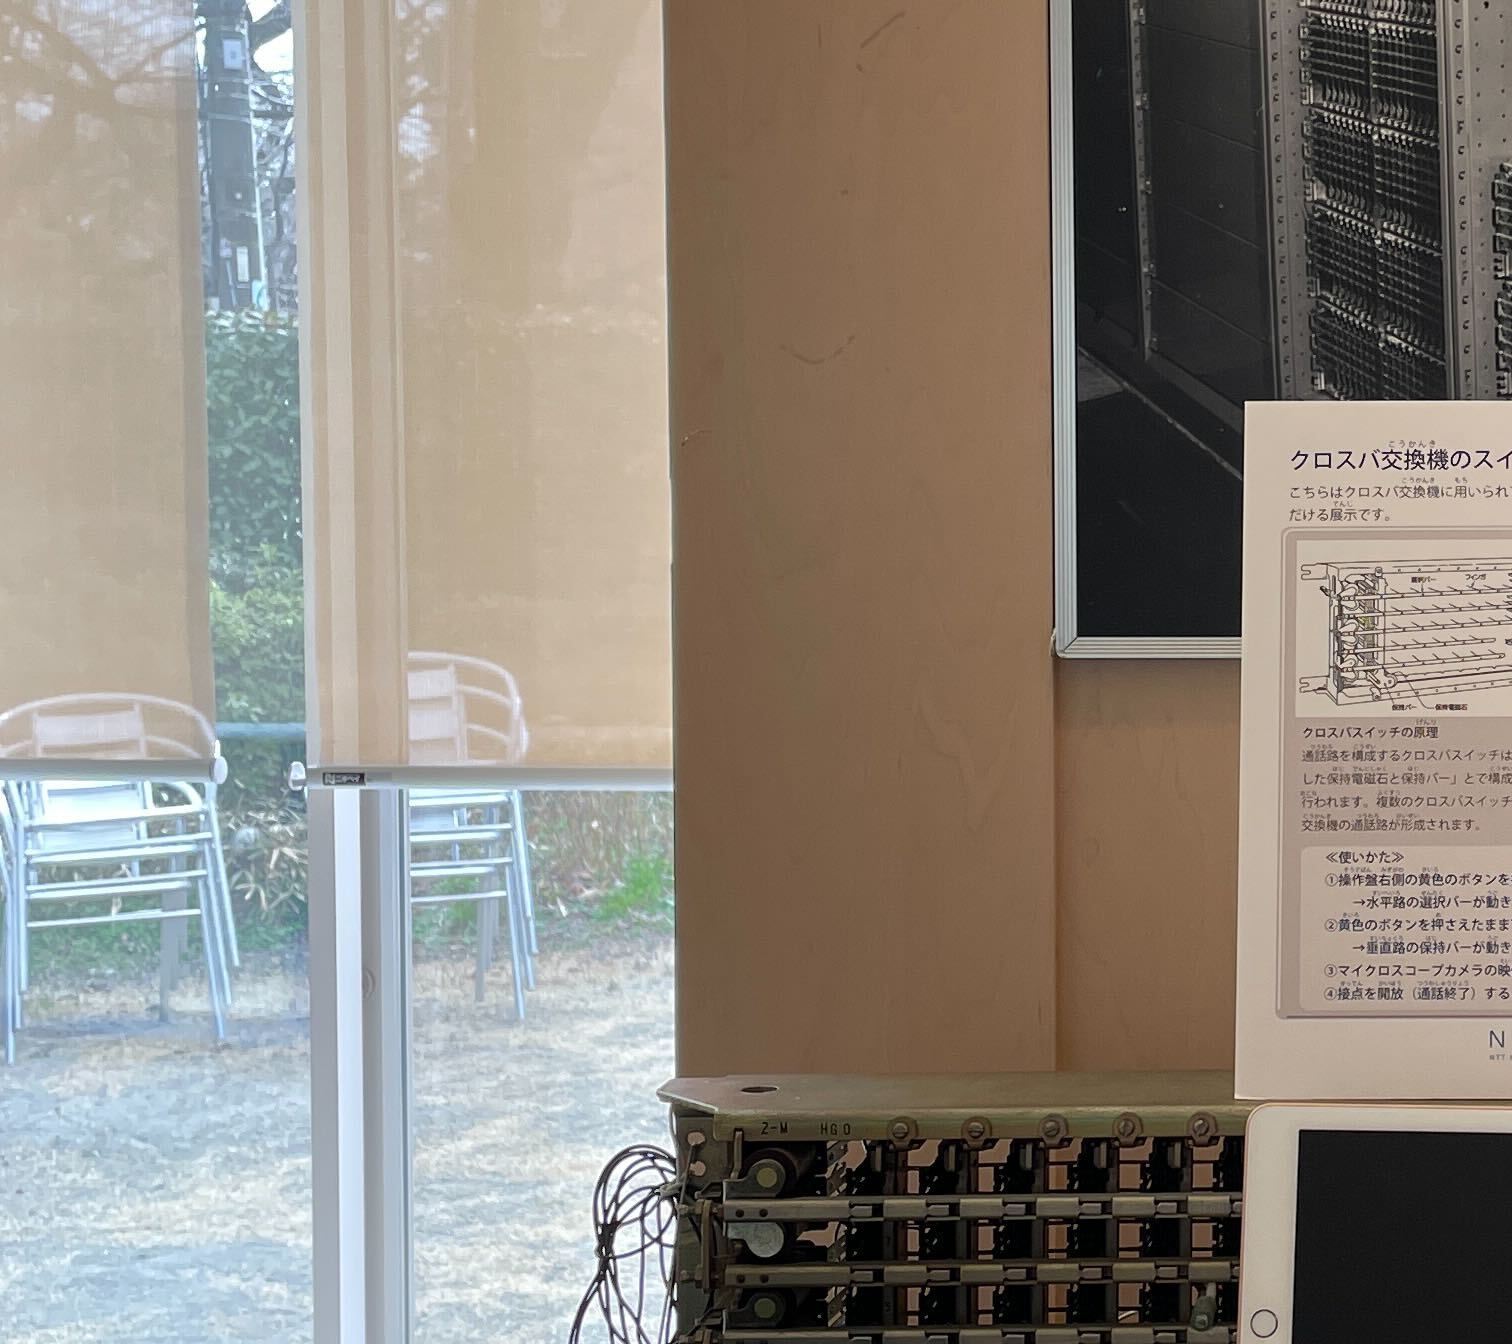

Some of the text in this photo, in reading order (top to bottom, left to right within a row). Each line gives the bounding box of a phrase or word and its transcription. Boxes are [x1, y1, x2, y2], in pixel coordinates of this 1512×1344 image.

[1289, 508, 1391, 522] だける展示です。
[1303, 727, 1438, 739] クロスバスイッチの原理
[1302, 819, 1480, 831] 交換機の通話路が形成されます。
